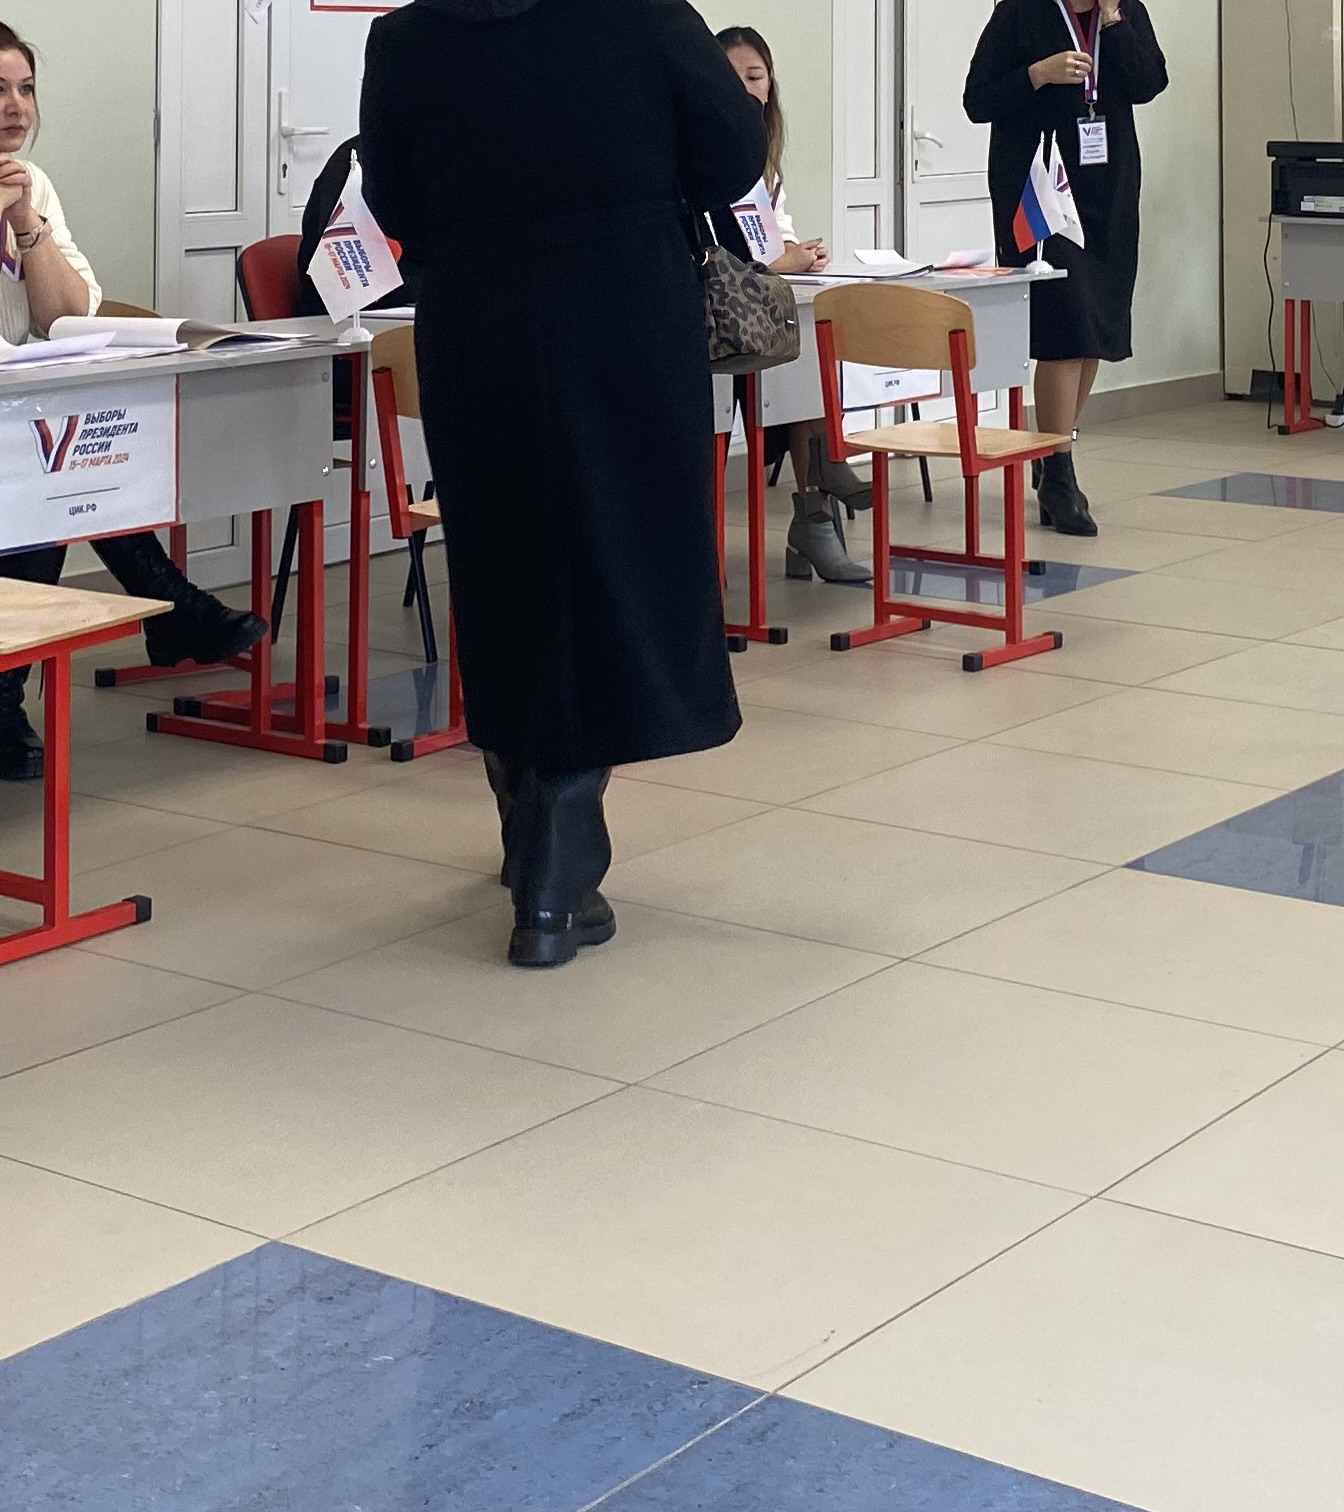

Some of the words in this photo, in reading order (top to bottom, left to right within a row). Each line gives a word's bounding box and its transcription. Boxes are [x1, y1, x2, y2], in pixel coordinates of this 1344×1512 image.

[332, 241, 353, 272] РОССИИ
[343, 240, 370, 287] ПРЕЗИДЕНТА
[353, 240, 373, 273] ВЫБОРЫ
[84, 408, 126, 425] ВЫБОРЫ
[78, 422, 139, 441] ПРЕЗИДЕНТА
[72, 440, 112, 456] РОССИИ
[88, 455, 112, 469] МАРТА
[112, 452, 130, 465] 2024
[69, 503, 97, 516] ЦИК.РФ
